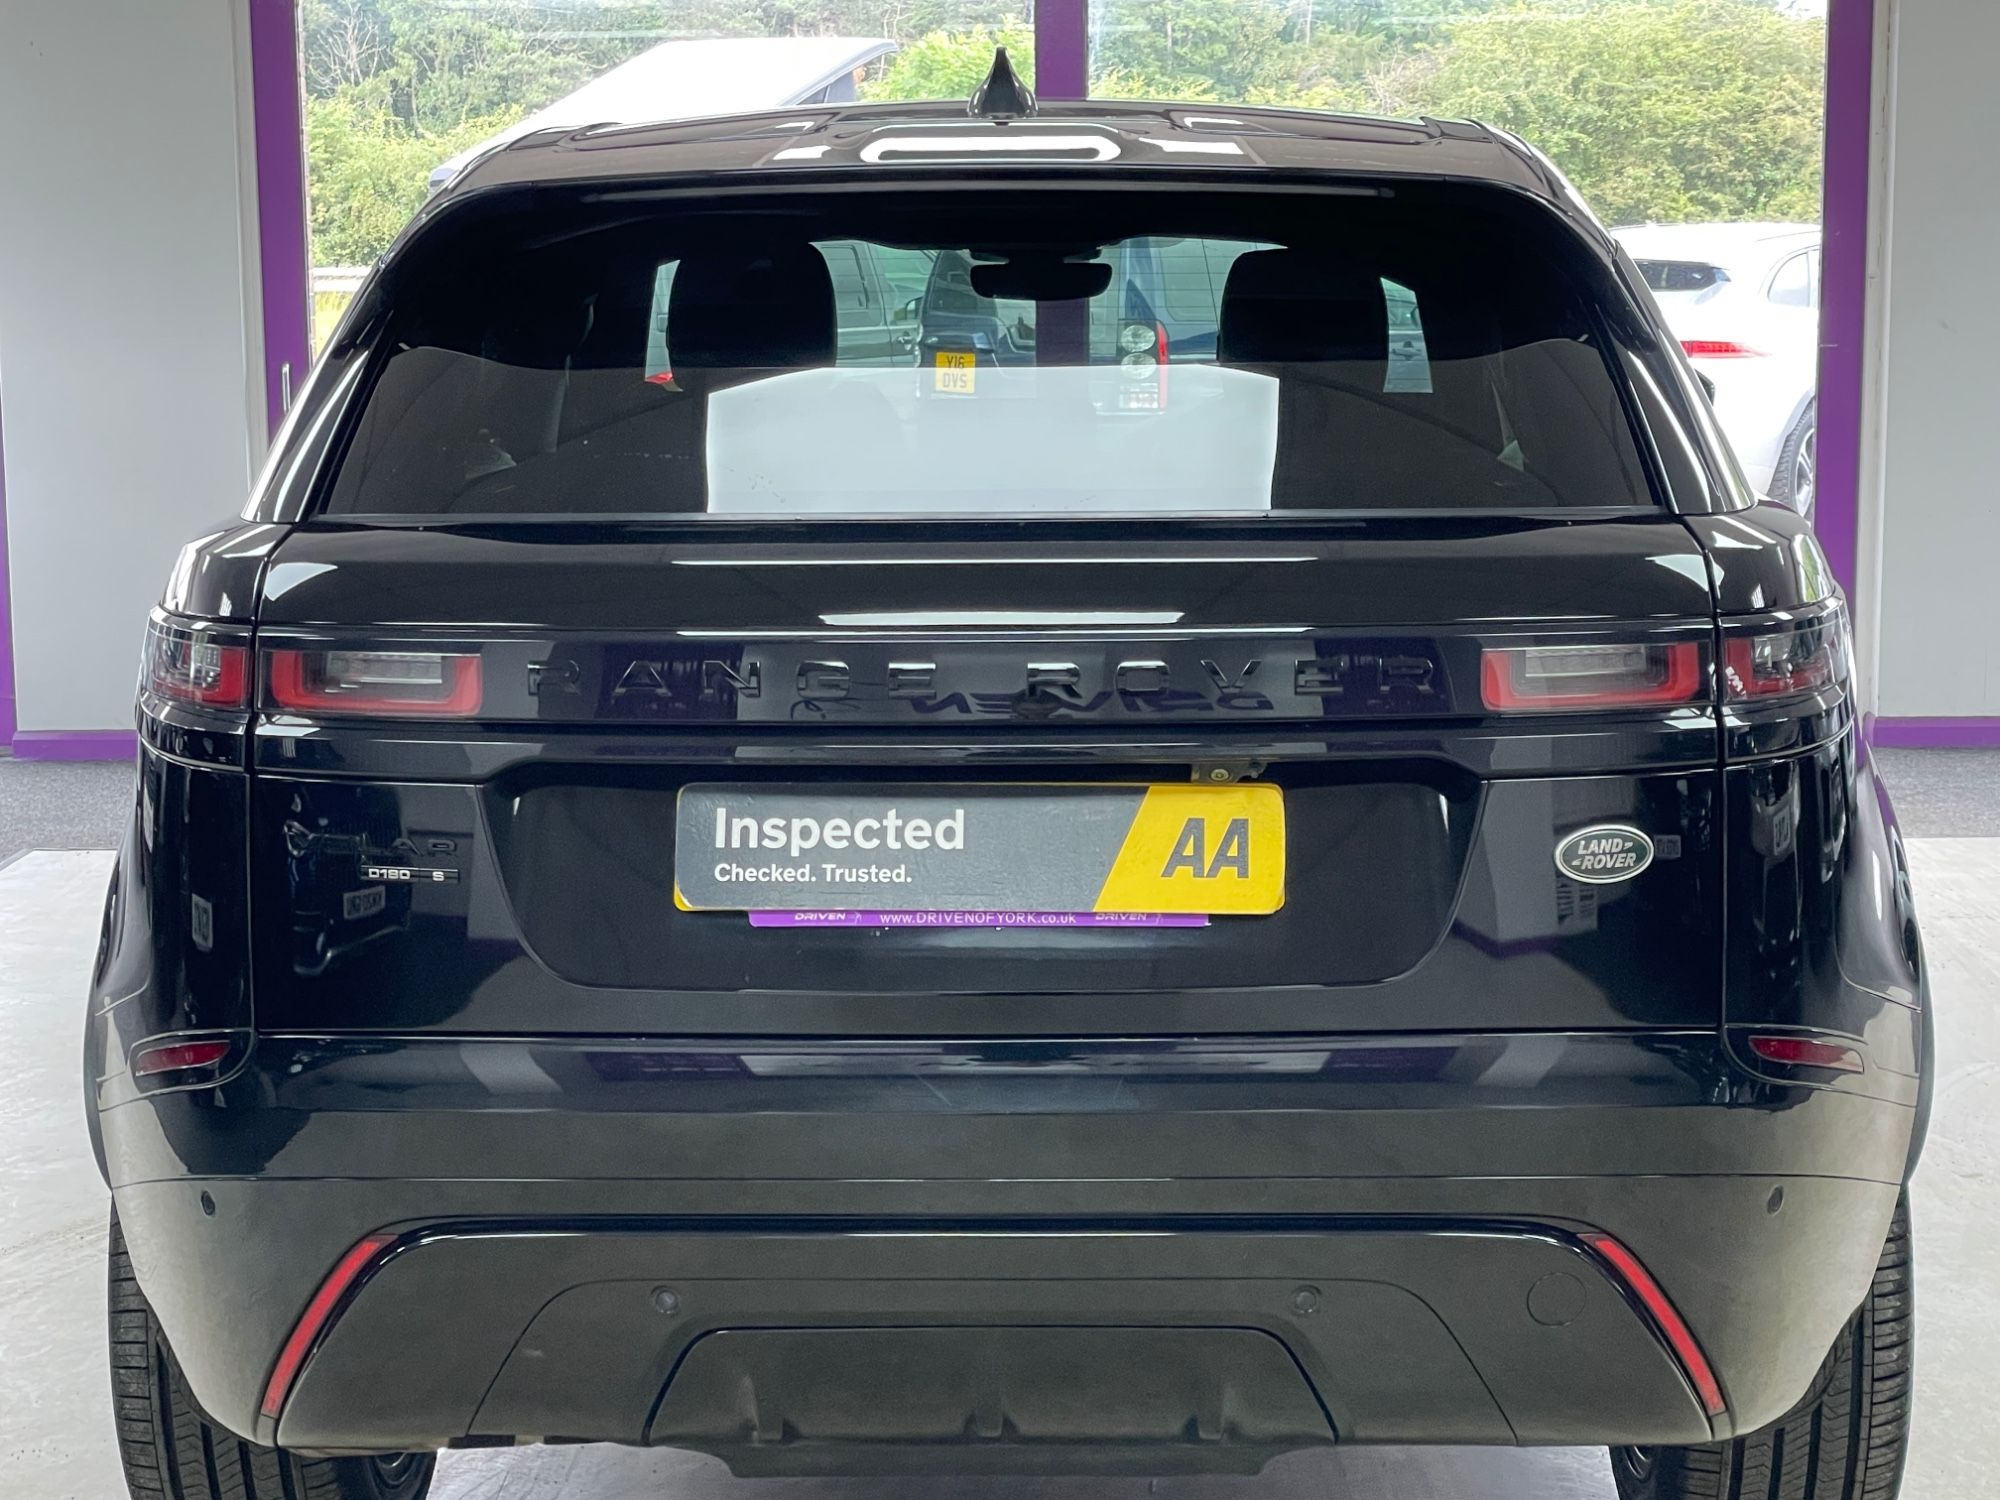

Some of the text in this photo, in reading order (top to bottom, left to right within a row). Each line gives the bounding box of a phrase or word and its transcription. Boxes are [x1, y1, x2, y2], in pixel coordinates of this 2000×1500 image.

[946, 356, 965, 369] Y16
[942, 373, 968, 389] DVS
[527, 660, 1434, 698] RANGE ROVER
[714, 807, 965, 857] Inspected
[1160, 817, 1250, 879] AA
[1577, 838, 1624, 855] LAND
[1581, 852, 1637, 870] ROVER
[368, 868, 445, 882] D180 S
[714, 862, 913, 884] Checked. Trusted.
[794, 912, 846, 921] DRIVEN
[880, 912, 1077, 924] www.DRIVENOFYORK.co.uk
[1095, 912, 1148, 921] DRIVEN
